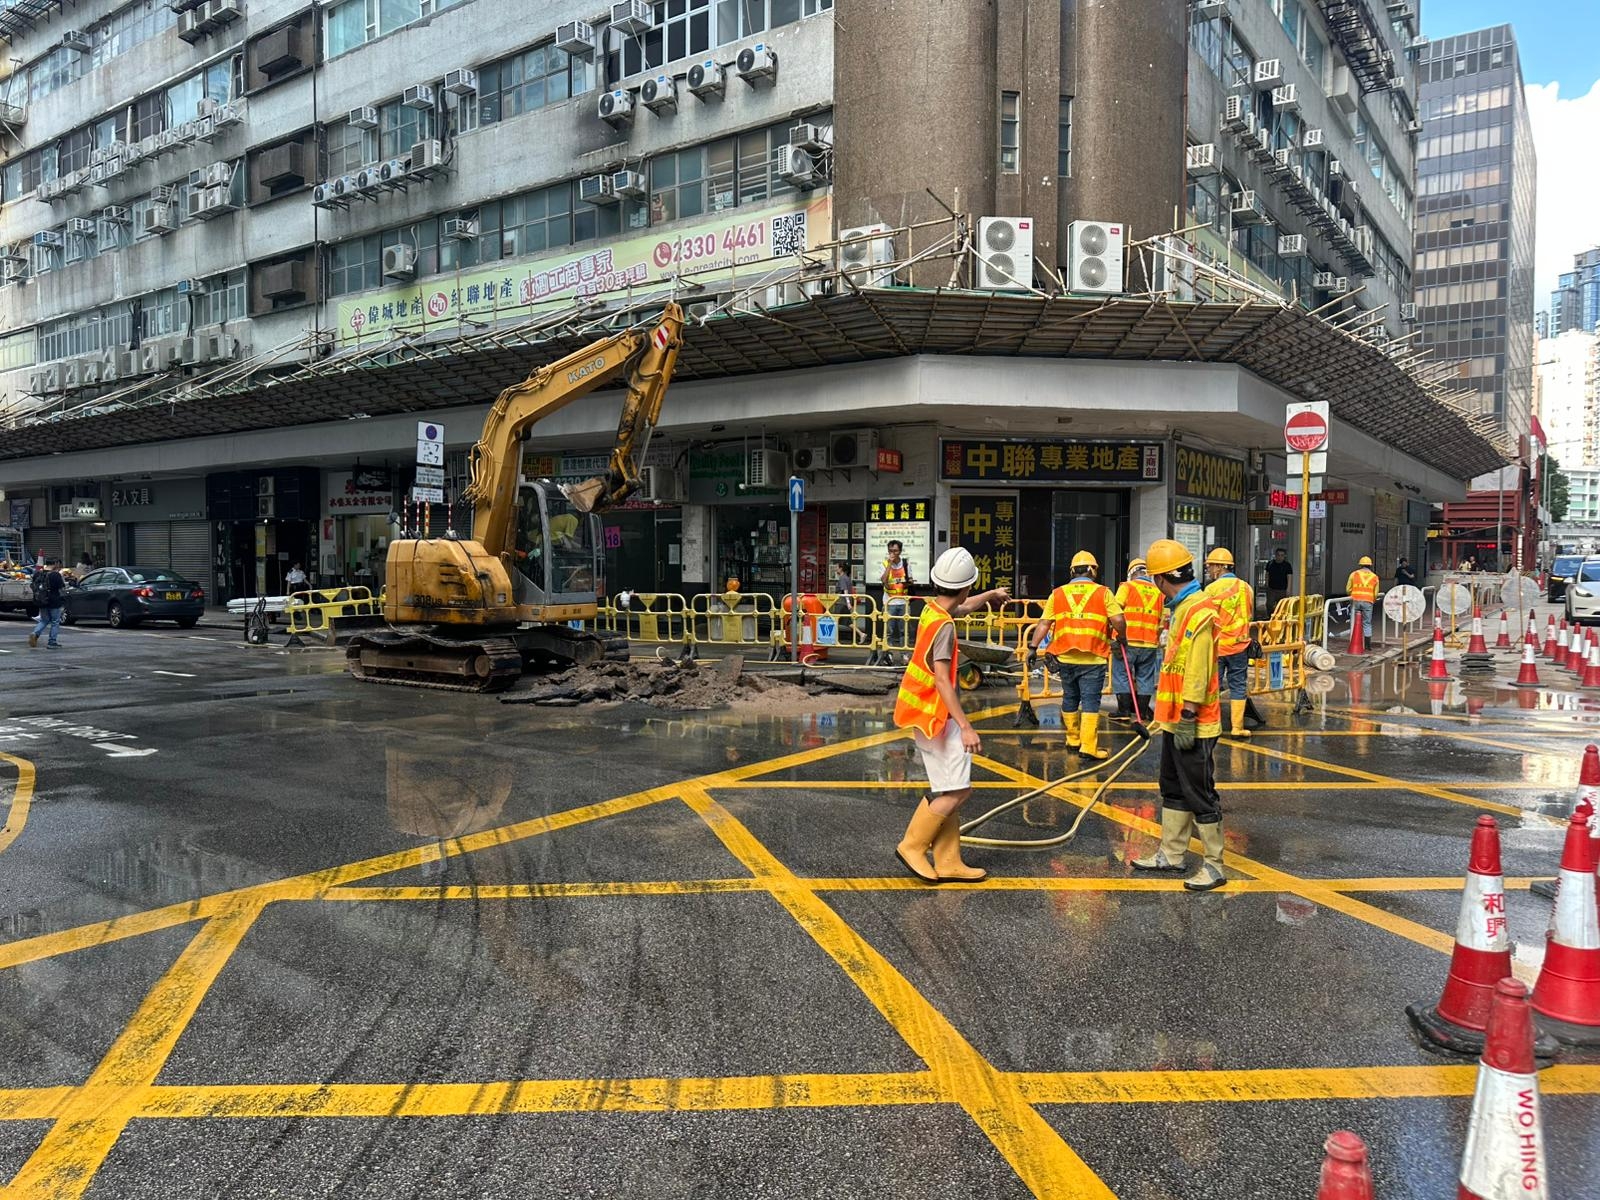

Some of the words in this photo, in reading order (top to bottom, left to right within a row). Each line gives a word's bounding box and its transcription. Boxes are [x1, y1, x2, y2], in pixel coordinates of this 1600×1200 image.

[673, 232, 716, 264] 2330
[722, 222, 765, 251] 4461
[520, 249, 613, 303] 紅磡工商專家
[660, 253, 760, 280] wwwe-greatcitycom
[431, 299, 445, 312] HU
[451, 278, 513, 308] 紅聯地產
[368, 296, 423, 325] 偉城地產
[568, 356, 605, 384] KATO
[967, 444, 1139, 477] 中聯專業地產
[1146, 447, 1157, 478] 工商部
[1188, 451, 1242, 500] 23309928
[112, 488, 150, 506] 名人文具
[994, 502, 1014, 597] 專業地產
[1518, 1089, 1536, 1128] WO
[1518, 1134, 1539, 1191] HING
